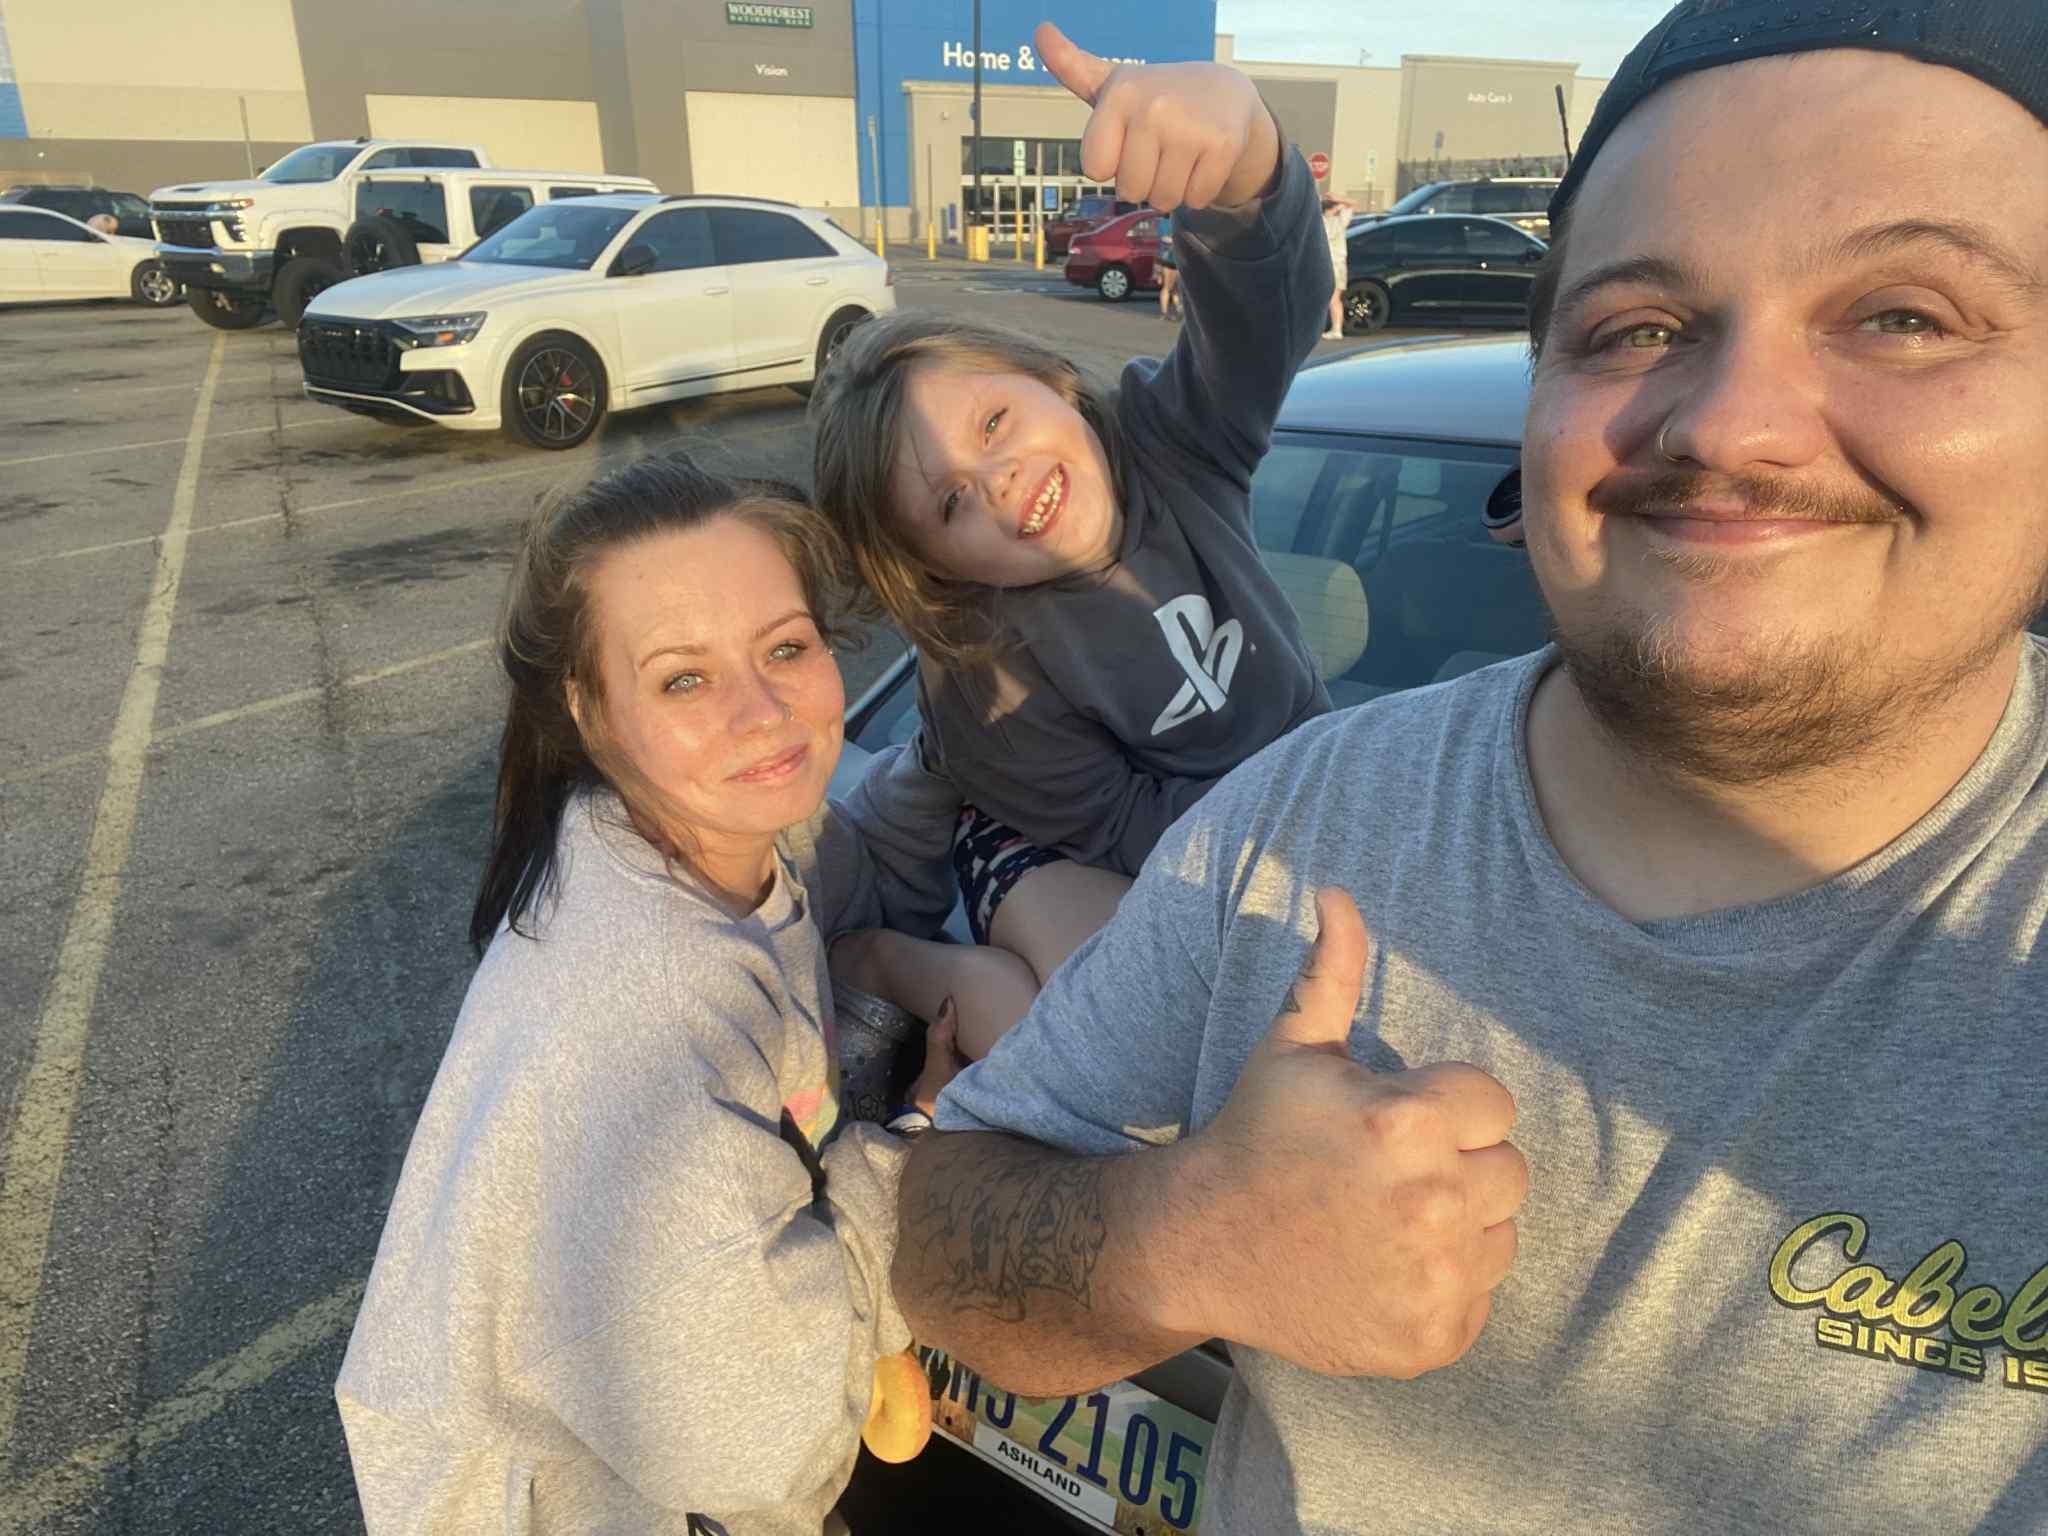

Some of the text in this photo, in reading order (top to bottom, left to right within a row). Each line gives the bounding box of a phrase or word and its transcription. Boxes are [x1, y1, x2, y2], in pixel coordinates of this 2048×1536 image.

[728, 3, 810, 20] WOODFOREST
[754, 63, 789, 77] Vision
[943, 41, 1011, 70] Home
[1018, 45, 1035, 70] &
[1816, 1316, 1985, 1382] SINCE
[997, 1439, 1082, 1498] ASHLAND
[1038, 1391, 1203, 1530] 2105
